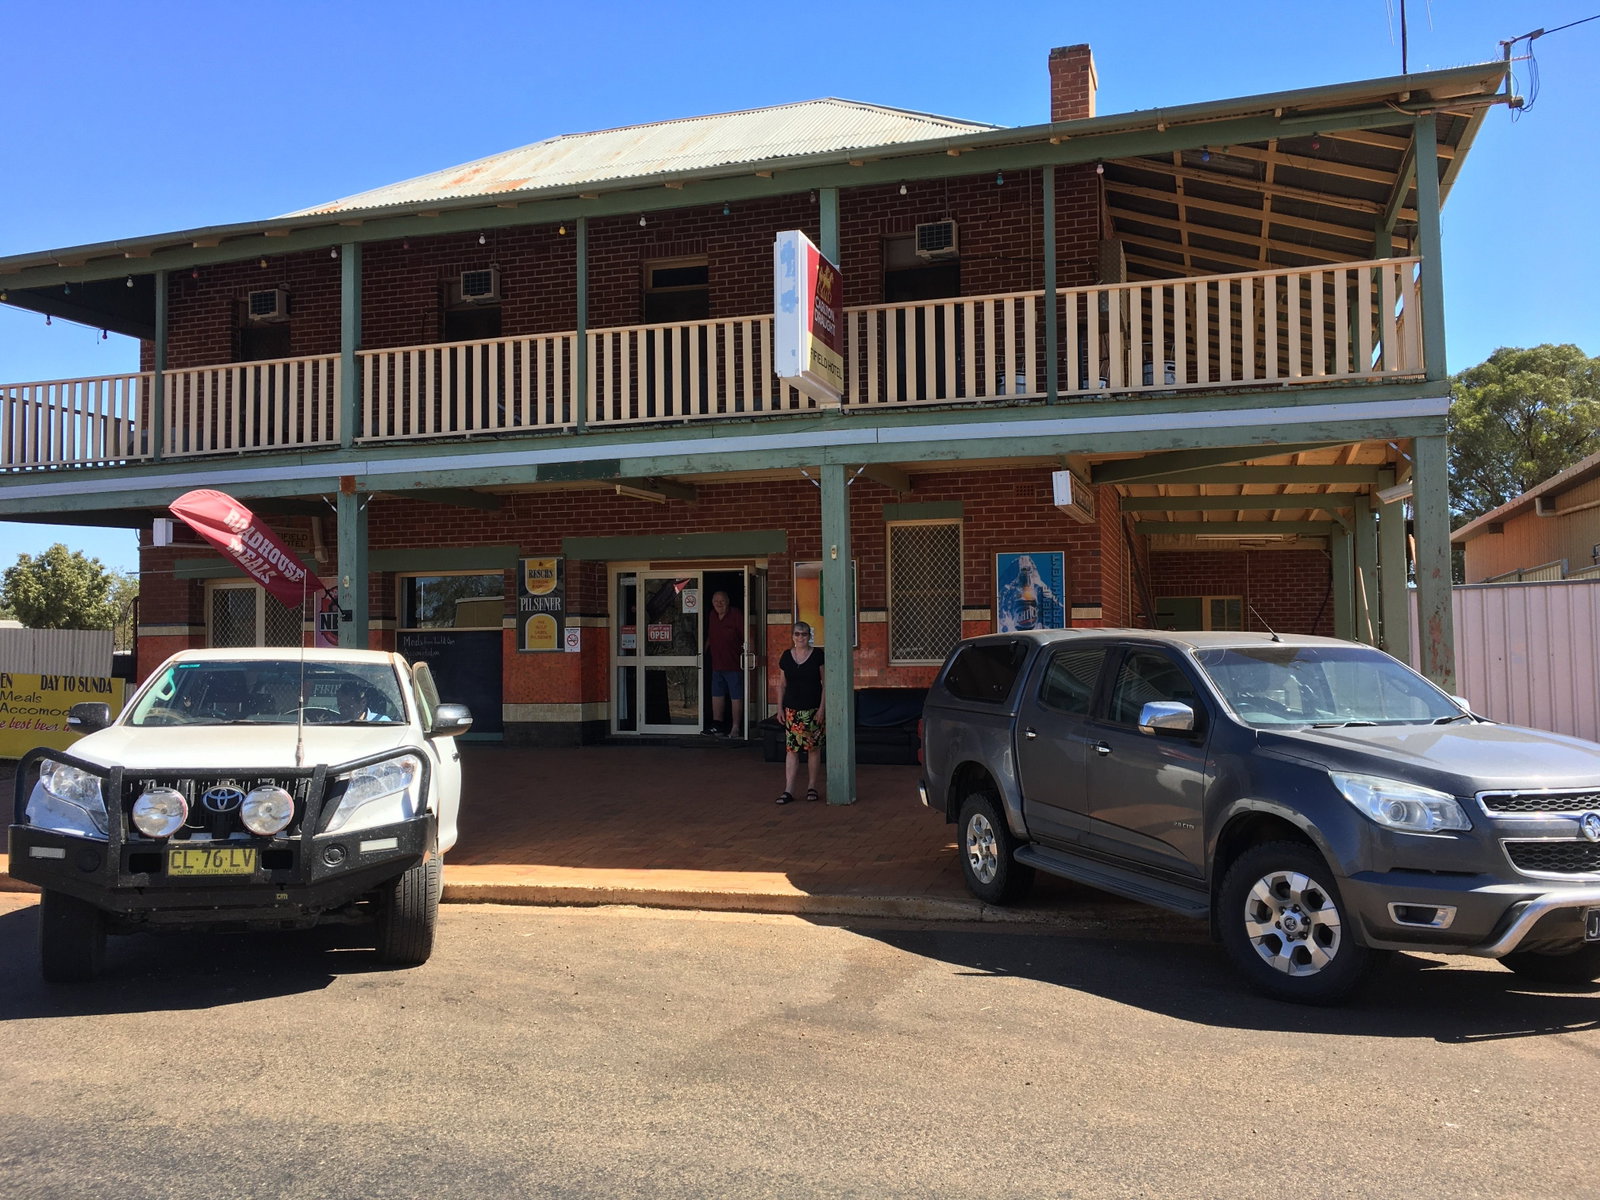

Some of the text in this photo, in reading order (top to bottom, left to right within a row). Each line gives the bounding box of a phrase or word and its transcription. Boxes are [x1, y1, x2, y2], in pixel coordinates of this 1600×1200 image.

[828, 360, 843, 380] HOTEL
[223, 508, 305, 583] ROADHOUSE
[226, 537, 278, 585] MEALS
[519, 597, 562, 612] PILSENER
[650, 631, 670, 640] OPEN
[41, 675, 61, 691] DAY
[63, 676, 75, 692] TO
[78, 677, 112, 694] SUNDA
[0, 691, 42, 703] Meals
[9, 718, 31, 729] best
[34, 719, 59, 731] beer
